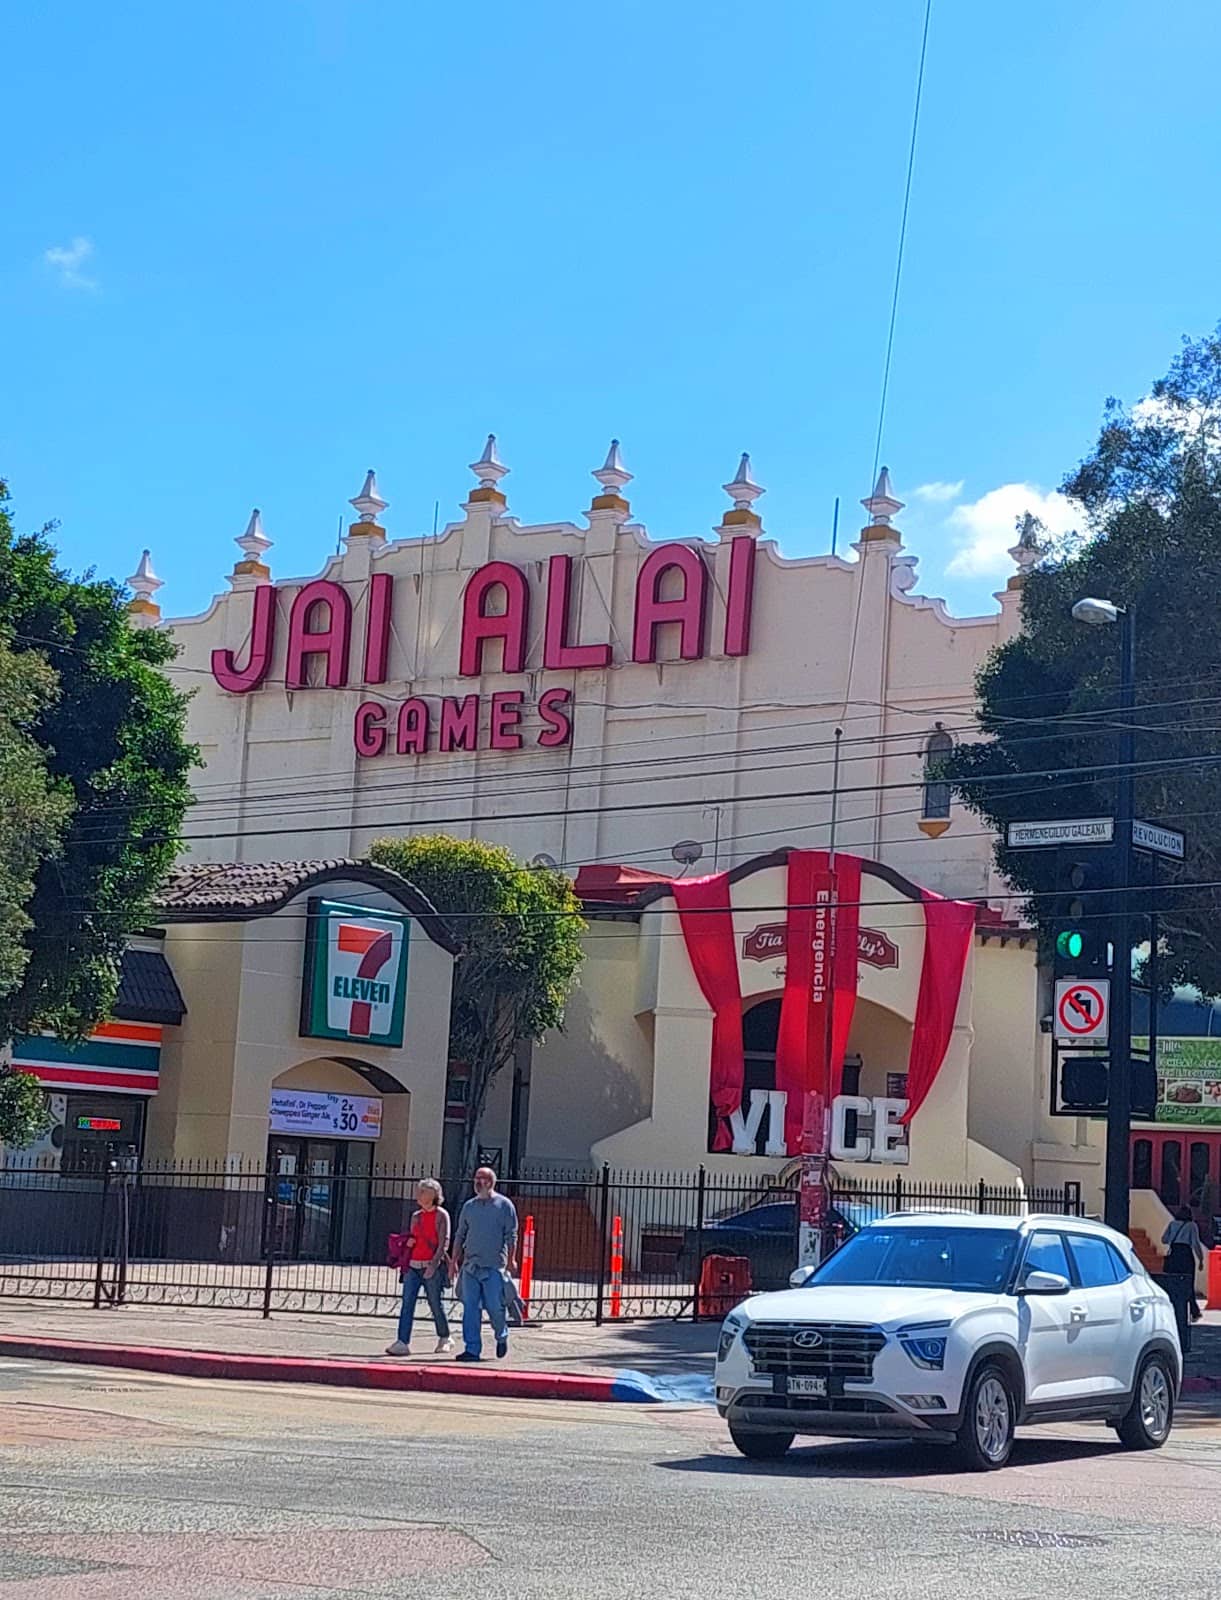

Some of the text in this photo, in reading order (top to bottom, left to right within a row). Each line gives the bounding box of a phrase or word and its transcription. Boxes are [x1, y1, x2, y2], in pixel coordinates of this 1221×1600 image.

[211, 536, 757, 693] JAI ALAI
[354, 687, 574, 758] GAMES
[1071, 823, 1106, 838] GALEANA
[1133, 825, 1182, 850] REVOLUCION
[337, 923, 394, 1037] 7
[341, 1098, 354, 1112] 2x
